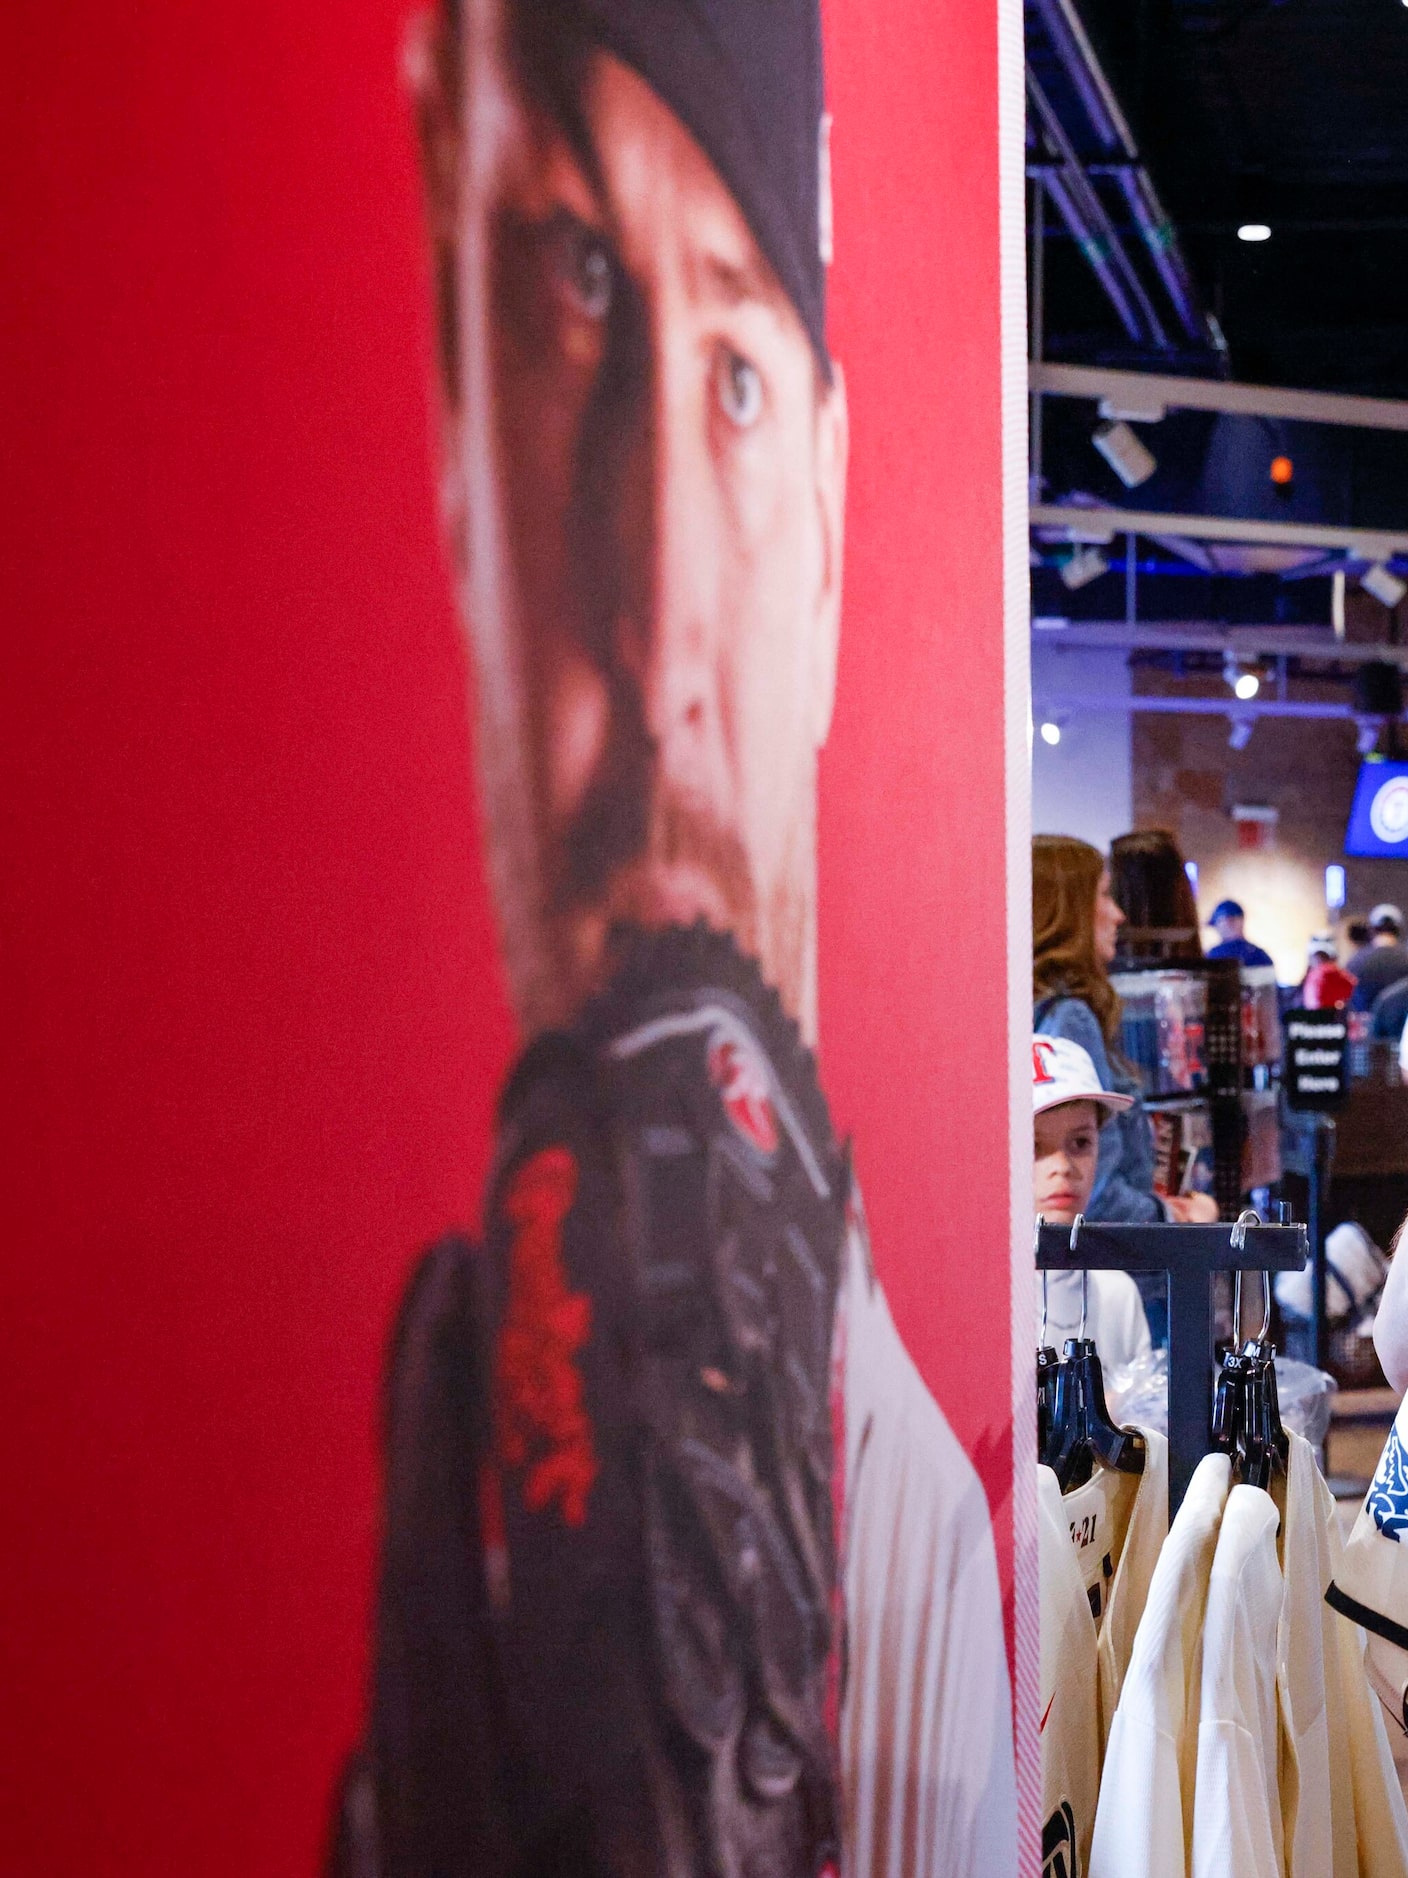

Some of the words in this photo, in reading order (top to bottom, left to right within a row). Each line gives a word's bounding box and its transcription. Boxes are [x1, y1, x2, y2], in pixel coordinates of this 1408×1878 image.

[1085, 1345, 1092, 1356] L
[1039, 1354, 1047, 1366] S
[1228, 1356, 1242, 1369] 3X
